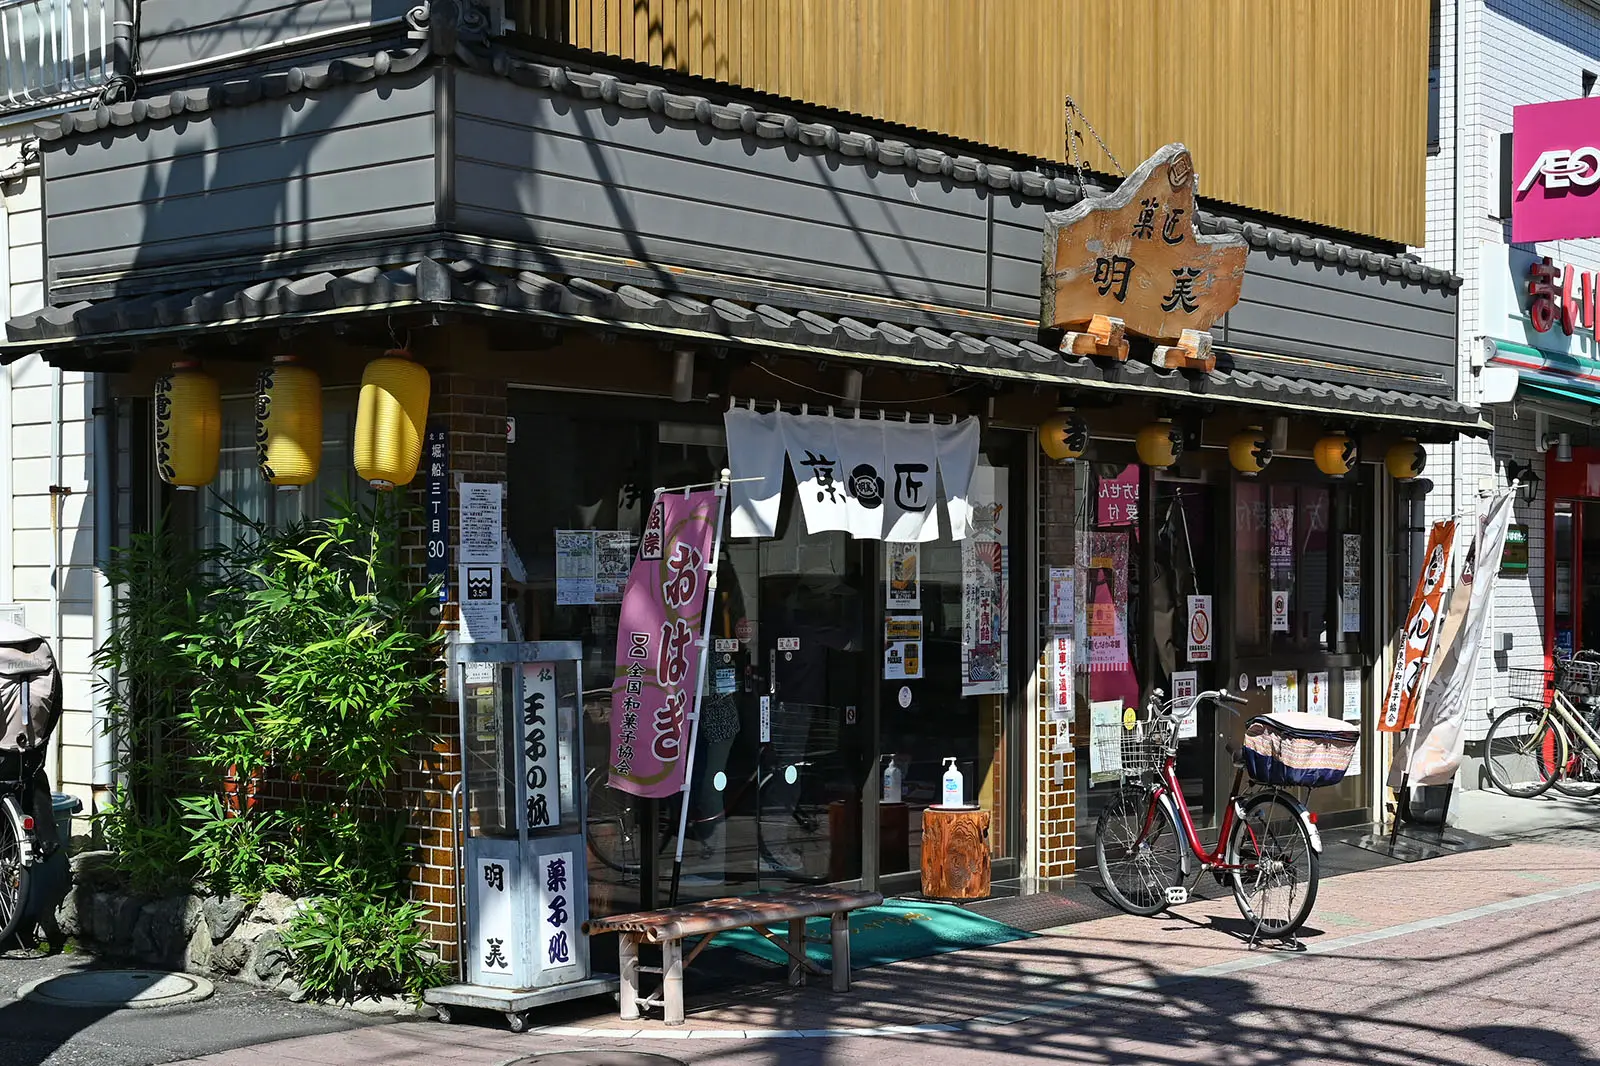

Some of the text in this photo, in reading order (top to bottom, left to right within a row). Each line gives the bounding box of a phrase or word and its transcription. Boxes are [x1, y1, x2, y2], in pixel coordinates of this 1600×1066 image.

[1131, 197, 1185, 246] 菓匠
[1093, 254, 1201, 314] 明美
[431, 443, 442, 534] 堀船三丁目
[893, 462, 929, 513] 匠
[428, 540, 445, 558] 30
[472, 589, 488, 598] 3.5m
[980, 598, 990, 642] 千歳飴
[652, 541, 703, 762] おはぎ
[1058, 637, 1068, 706] 駐車ご遠慮
[615, 662, 647, 776] 全国和菓子協会
